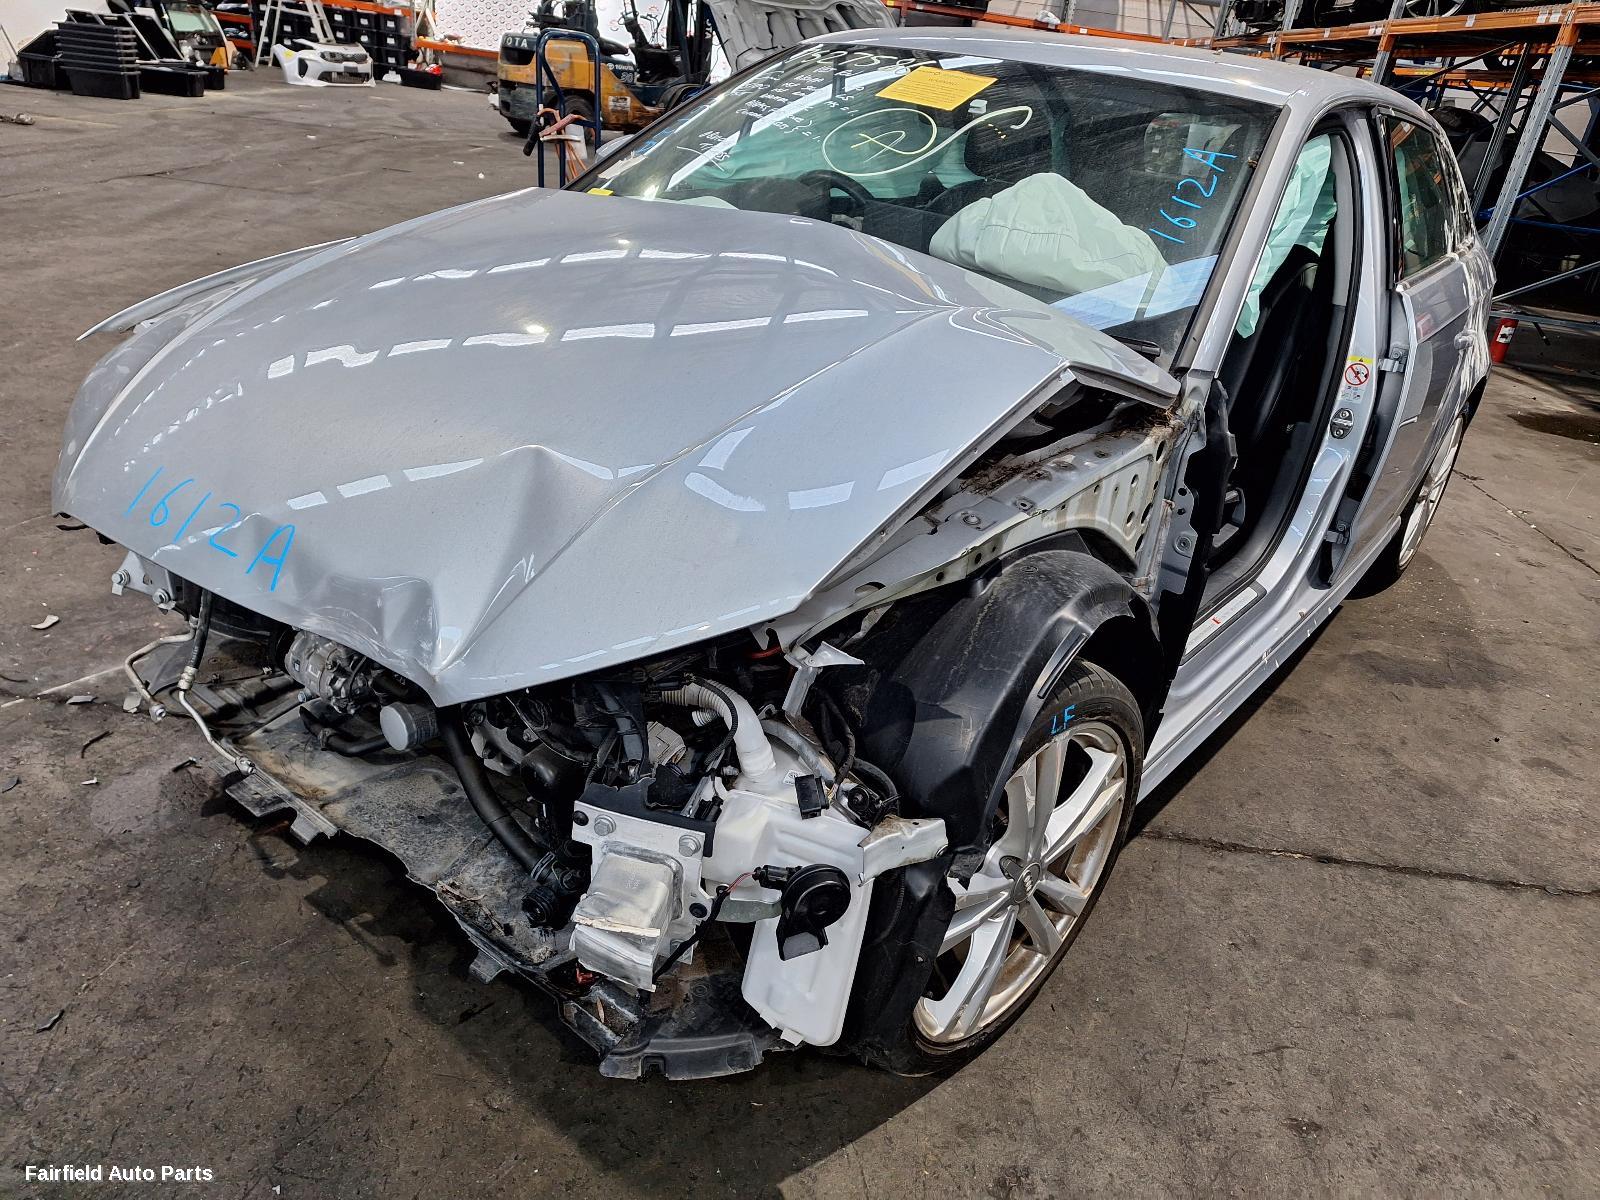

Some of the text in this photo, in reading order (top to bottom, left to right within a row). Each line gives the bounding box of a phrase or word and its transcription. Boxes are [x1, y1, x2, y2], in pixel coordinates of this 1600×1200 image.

[503, 36, 528, 48] OTA
[1149, 147, 1239, 244] 1612A
[122, 465, 297, 593] 1612A
[1050, 703, 1078, 736] LF
